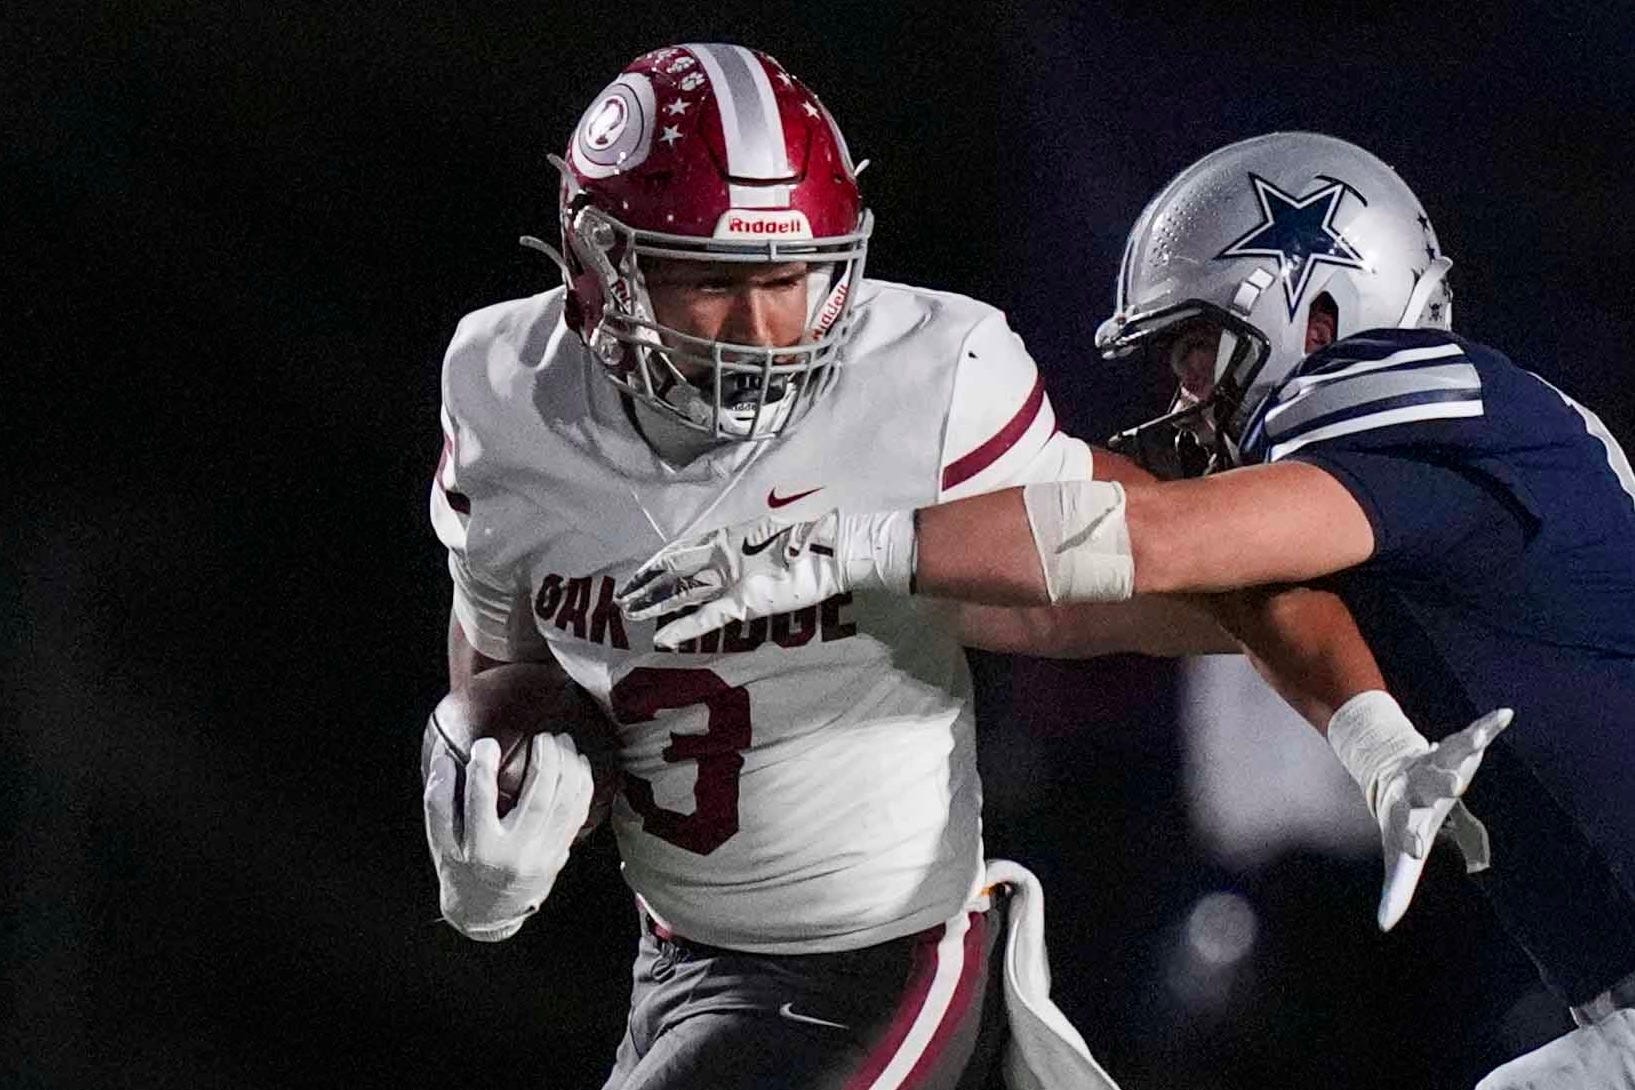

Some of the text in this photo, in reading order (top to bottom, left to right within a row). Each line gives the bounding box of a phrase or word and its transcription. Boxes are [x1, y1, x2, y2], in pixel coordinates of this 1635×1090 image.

[729, 218, 801, 233] Riddell
[535, 573, 631, 651] OAK
[611, 667, 751, 856] 3
